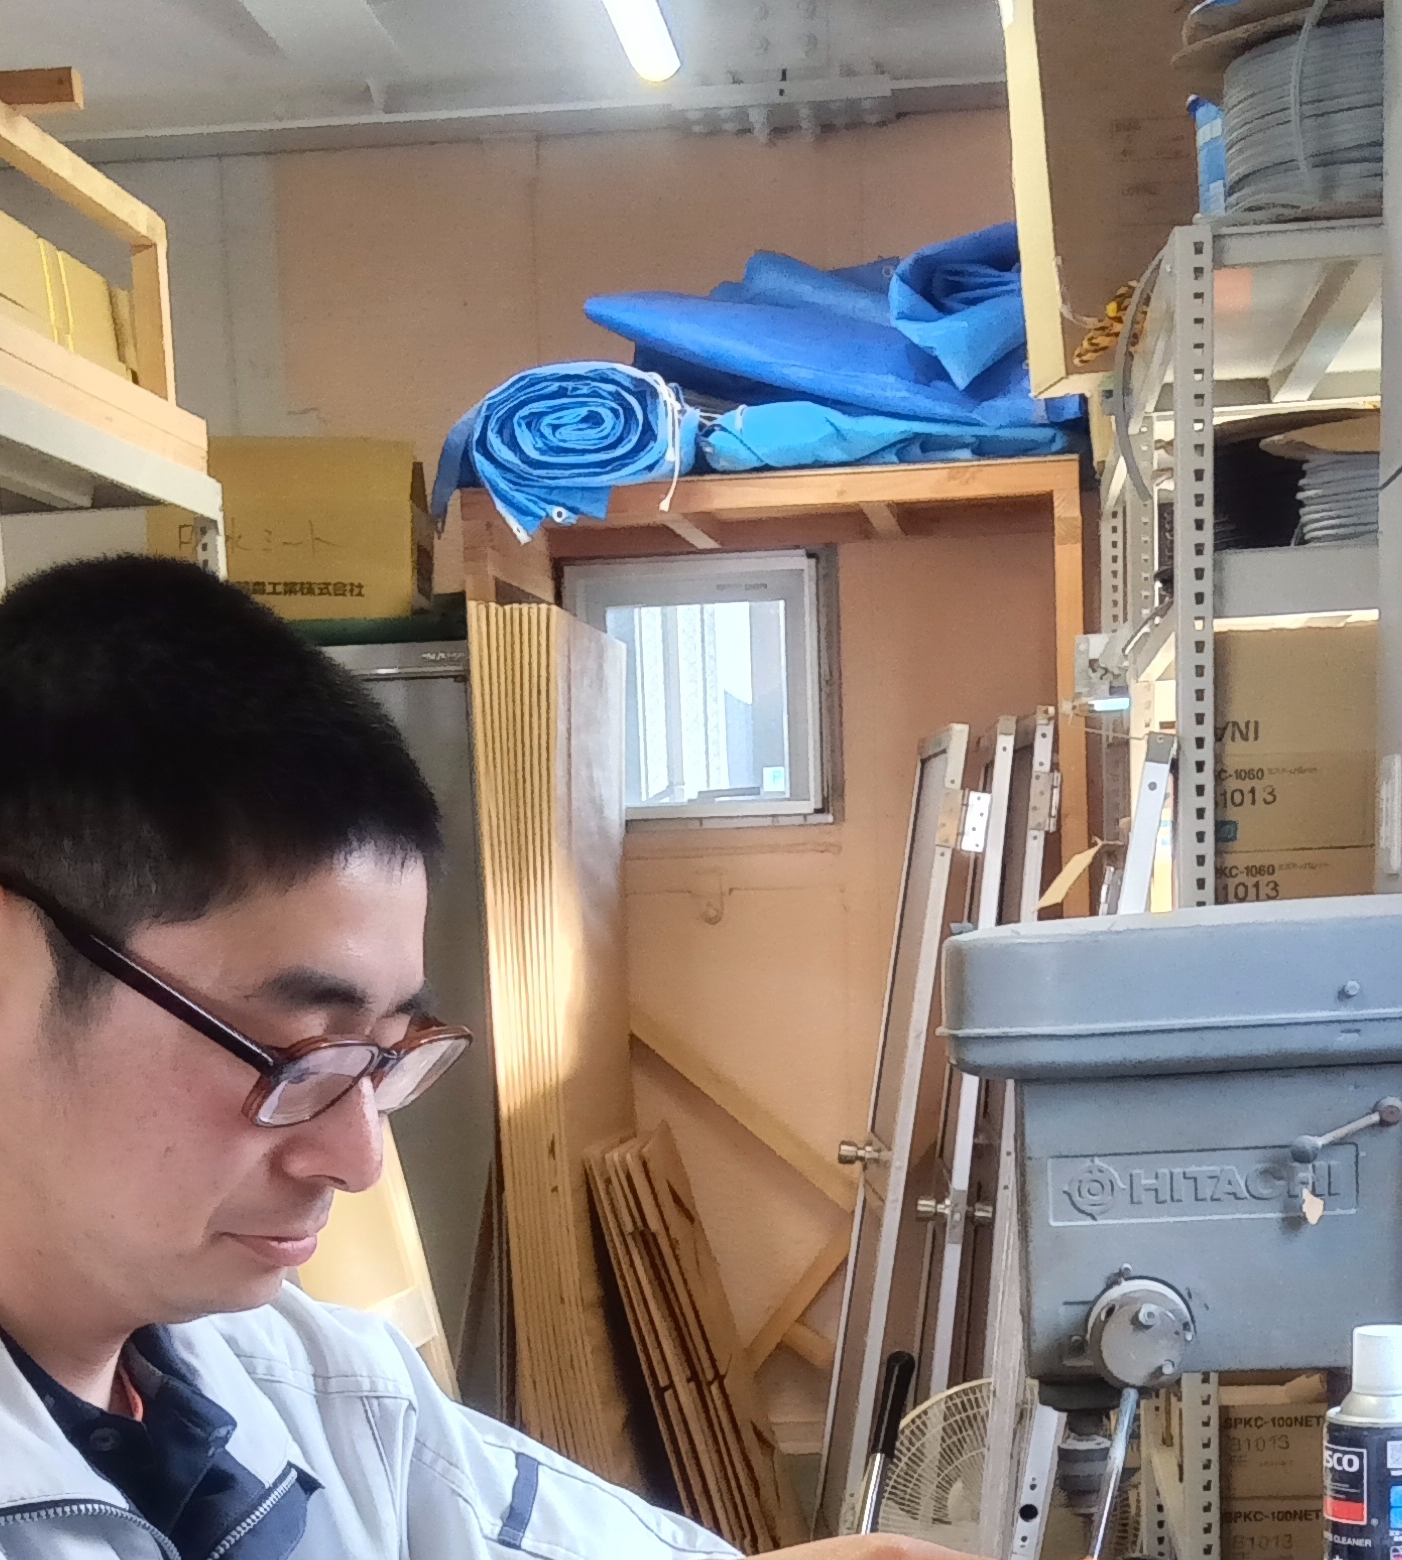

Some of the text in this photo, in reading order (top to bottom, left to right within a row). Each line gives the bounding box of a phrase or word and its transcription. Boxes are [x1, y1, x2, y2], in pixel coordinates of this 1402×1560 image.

[1215, 785, 1277, 808] 1013
[1215, 880, 1281, 904] 1013
[1129, 1161, 1341, 1206] HITACHI
